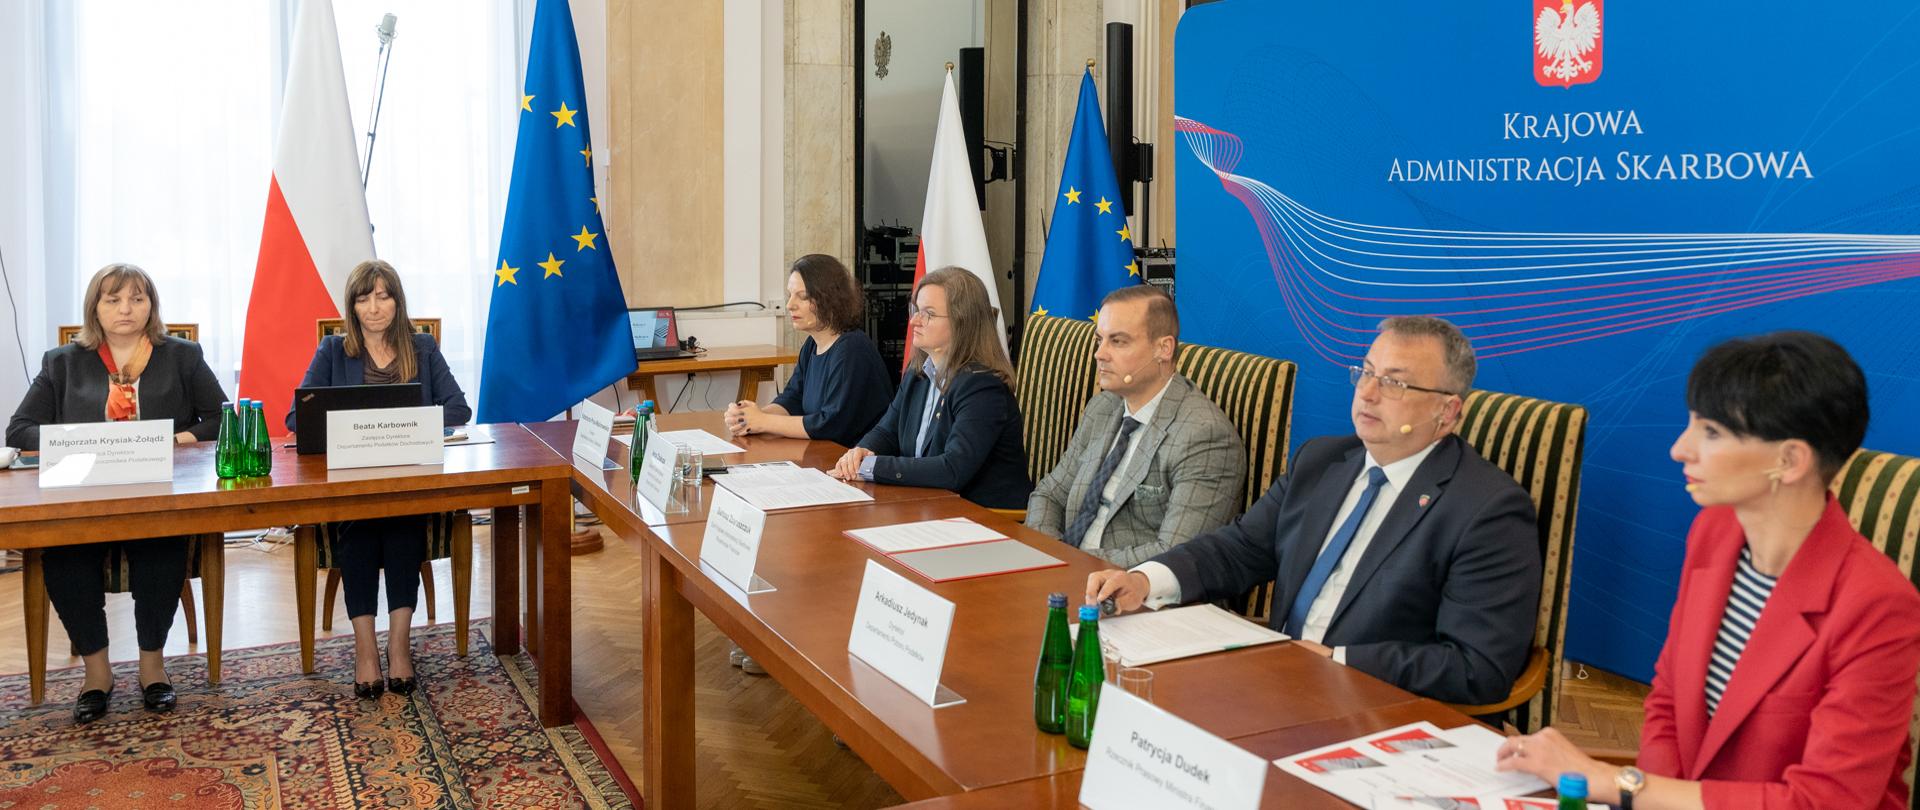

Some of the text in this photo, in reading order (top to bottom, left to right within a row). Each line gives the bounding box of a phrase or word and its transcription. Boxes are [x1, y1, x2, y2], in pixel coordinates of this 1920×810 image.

[1503, 109, 1644, 144] KRAJOWA
[1388, 151, 1815, 187] ADMINISTRACJA SKARBOWA
[377, 421, 418, 429] Karbownik
[49, 439, 98, 448] Małgorzata
[875, 591, 928, 628] Arkadiusz Jedynak
[1130, 730, 1211, 785] Patrycja Dudek
